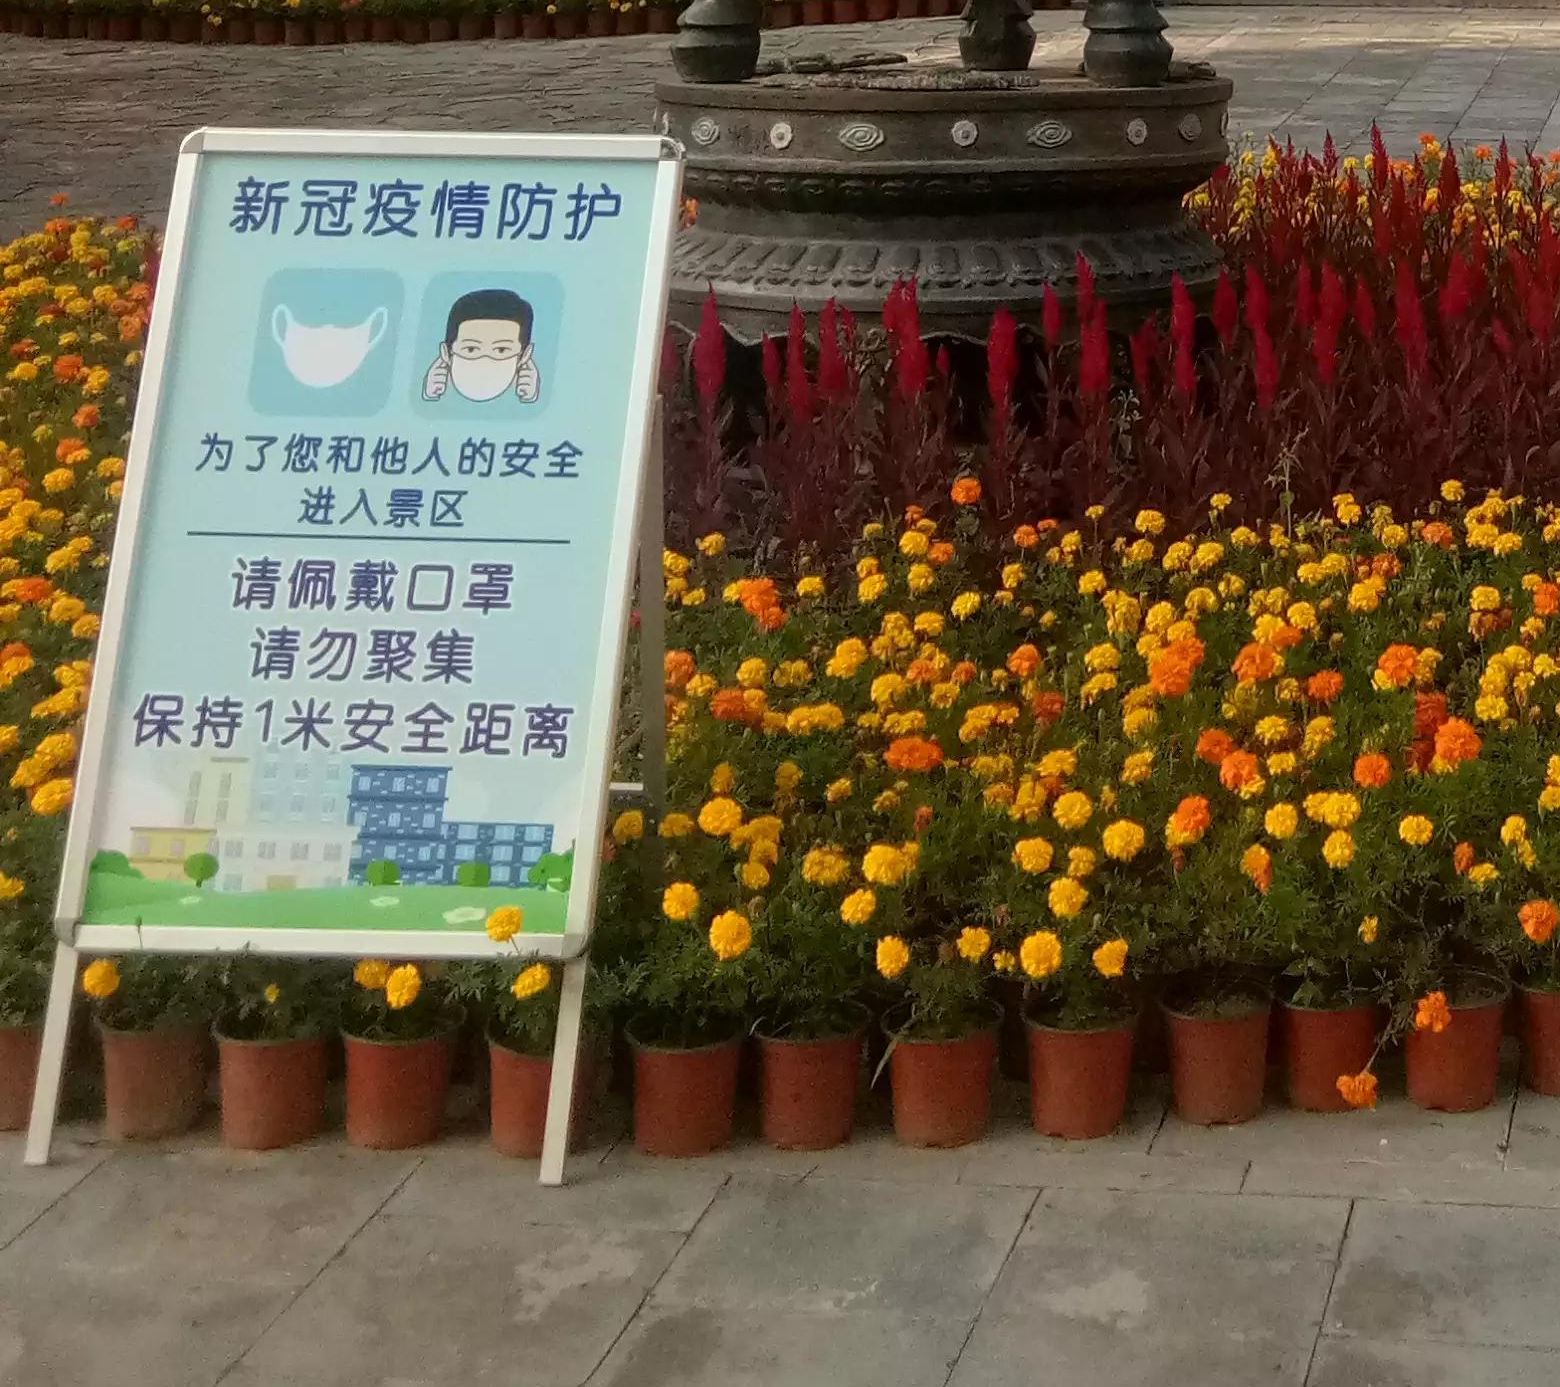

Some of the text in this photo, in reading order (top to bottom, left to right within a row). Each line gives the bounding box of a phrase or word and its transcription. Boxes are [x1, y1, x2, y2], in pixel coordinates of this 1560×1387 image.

[229, 176, 622, 241] 新冠疫情防护
[195, 432, 584, 478] 为了您和他人的安全
[297, 486, 469, 528] 进入景区
[230, 555, 515, 615] 请佩戴口罩
[249, 626, 476, 684] 请勿聚集
[132, 692, 575, 759] 保持1米安全距离
